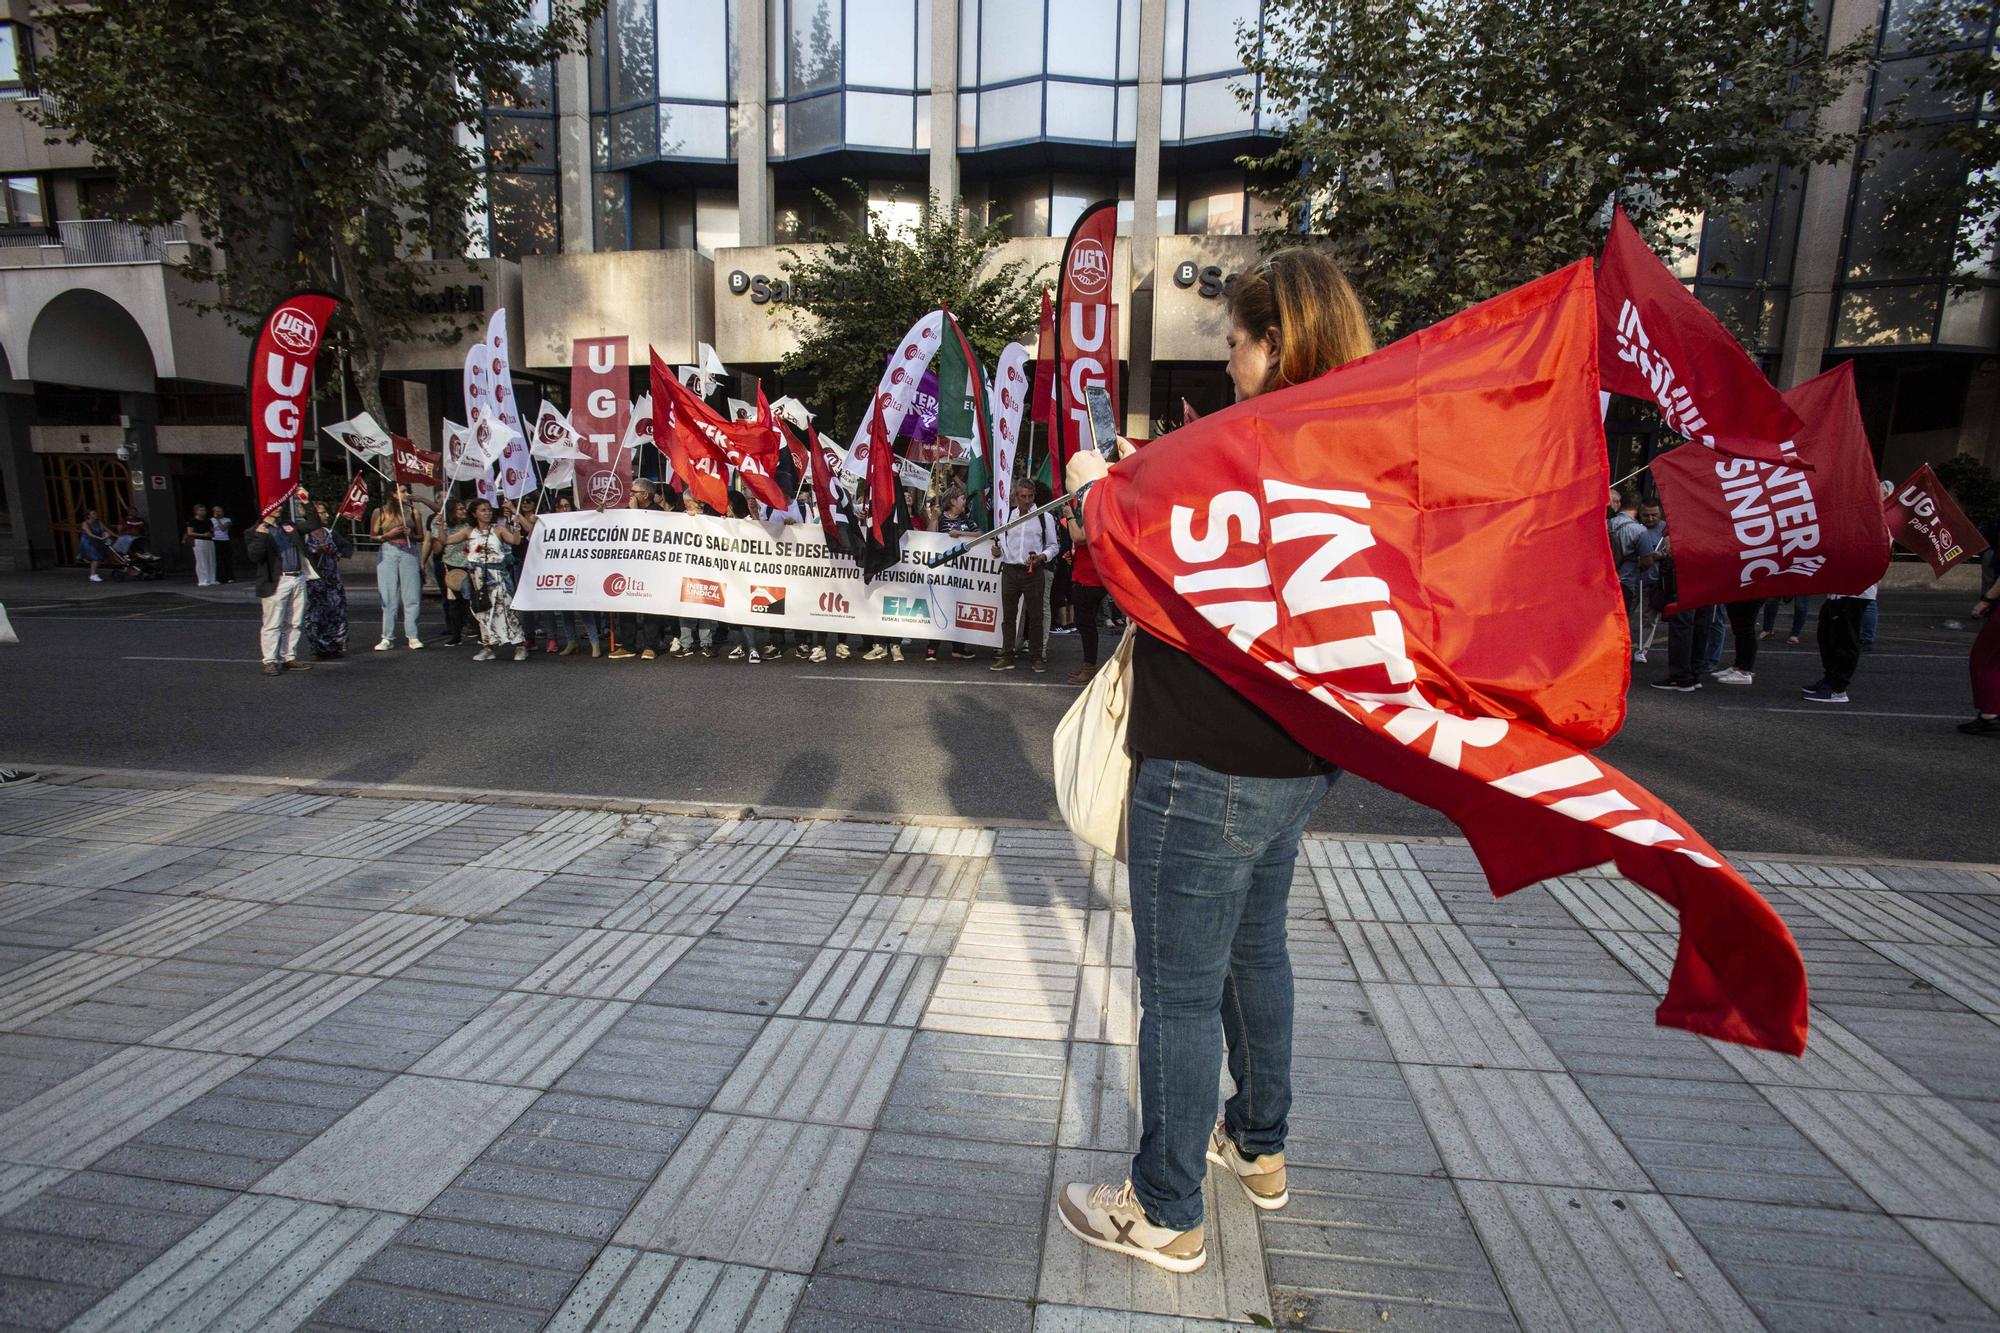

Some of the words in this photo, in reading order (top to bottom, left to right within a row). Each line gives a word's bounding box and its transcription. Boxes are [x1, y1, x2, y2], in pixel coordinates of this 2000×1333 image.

[1073, 249, 1105, 271] UGT
[278, 312, 314, 342] UGT
[587, 345, 617, 463] UGT
[264, 352, 308, 480] UGT
[543, 529, 556, 542] LA
[558, 525, 629, 542] DIRECCIÓN
[632, 528, 650, 542] DE
[653, 529, 703, 548] BANCO
[706, 535, 772, 556] SABADELL
[775, 541, 792, 557] SE
[545, 549, 560, 559] FIN
[561, 548, 568, 559] A
[570, 548, 589, 559] LAS
[668, 552, 682, 563] DE
[684, 553, 729, 571] TRABAJO
[731, 560, 737, 571] Y
[739, 561, 752, 572] AL
[754, 562, 782, 575] CAOS
[784, 564, 860, 579] ORGANIZATIVO
[927, 573, 975, 590] SALARIAL
[536, 575, 563, 587] UGT
[752, 604, 770, 613] CGT
[819, 591, 850, 613] CIG
[882, 595, 931, 618] ELA
[957, 605, 995, 623] LAB
